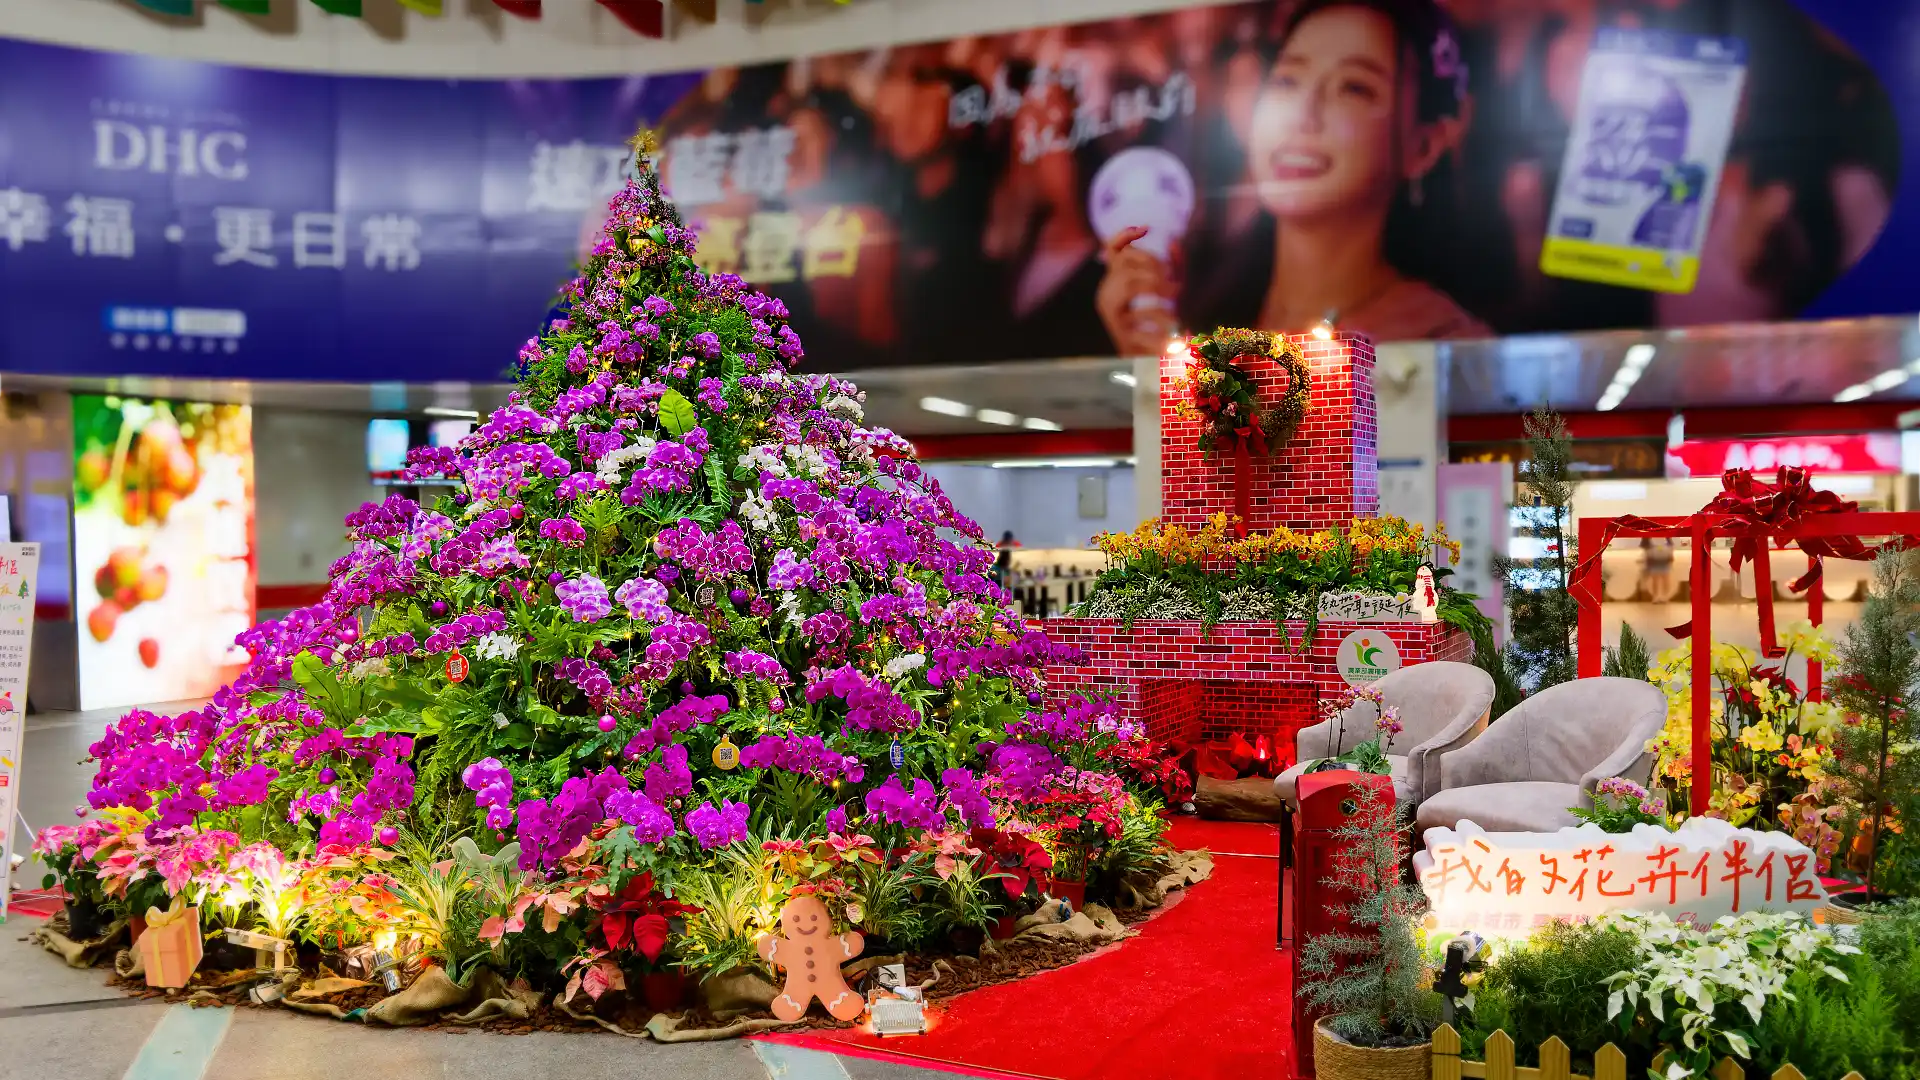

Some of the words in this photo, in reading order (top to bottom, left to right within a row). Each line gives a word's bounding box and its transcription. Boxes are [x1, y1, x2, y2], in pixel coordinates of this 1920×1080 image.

[93, 119, 249, 182] DHC
[1319, 595, 1419, 620] 熱帶聖誕夜
[1426, 838, 1822, 913] 我的花卉伴侶
